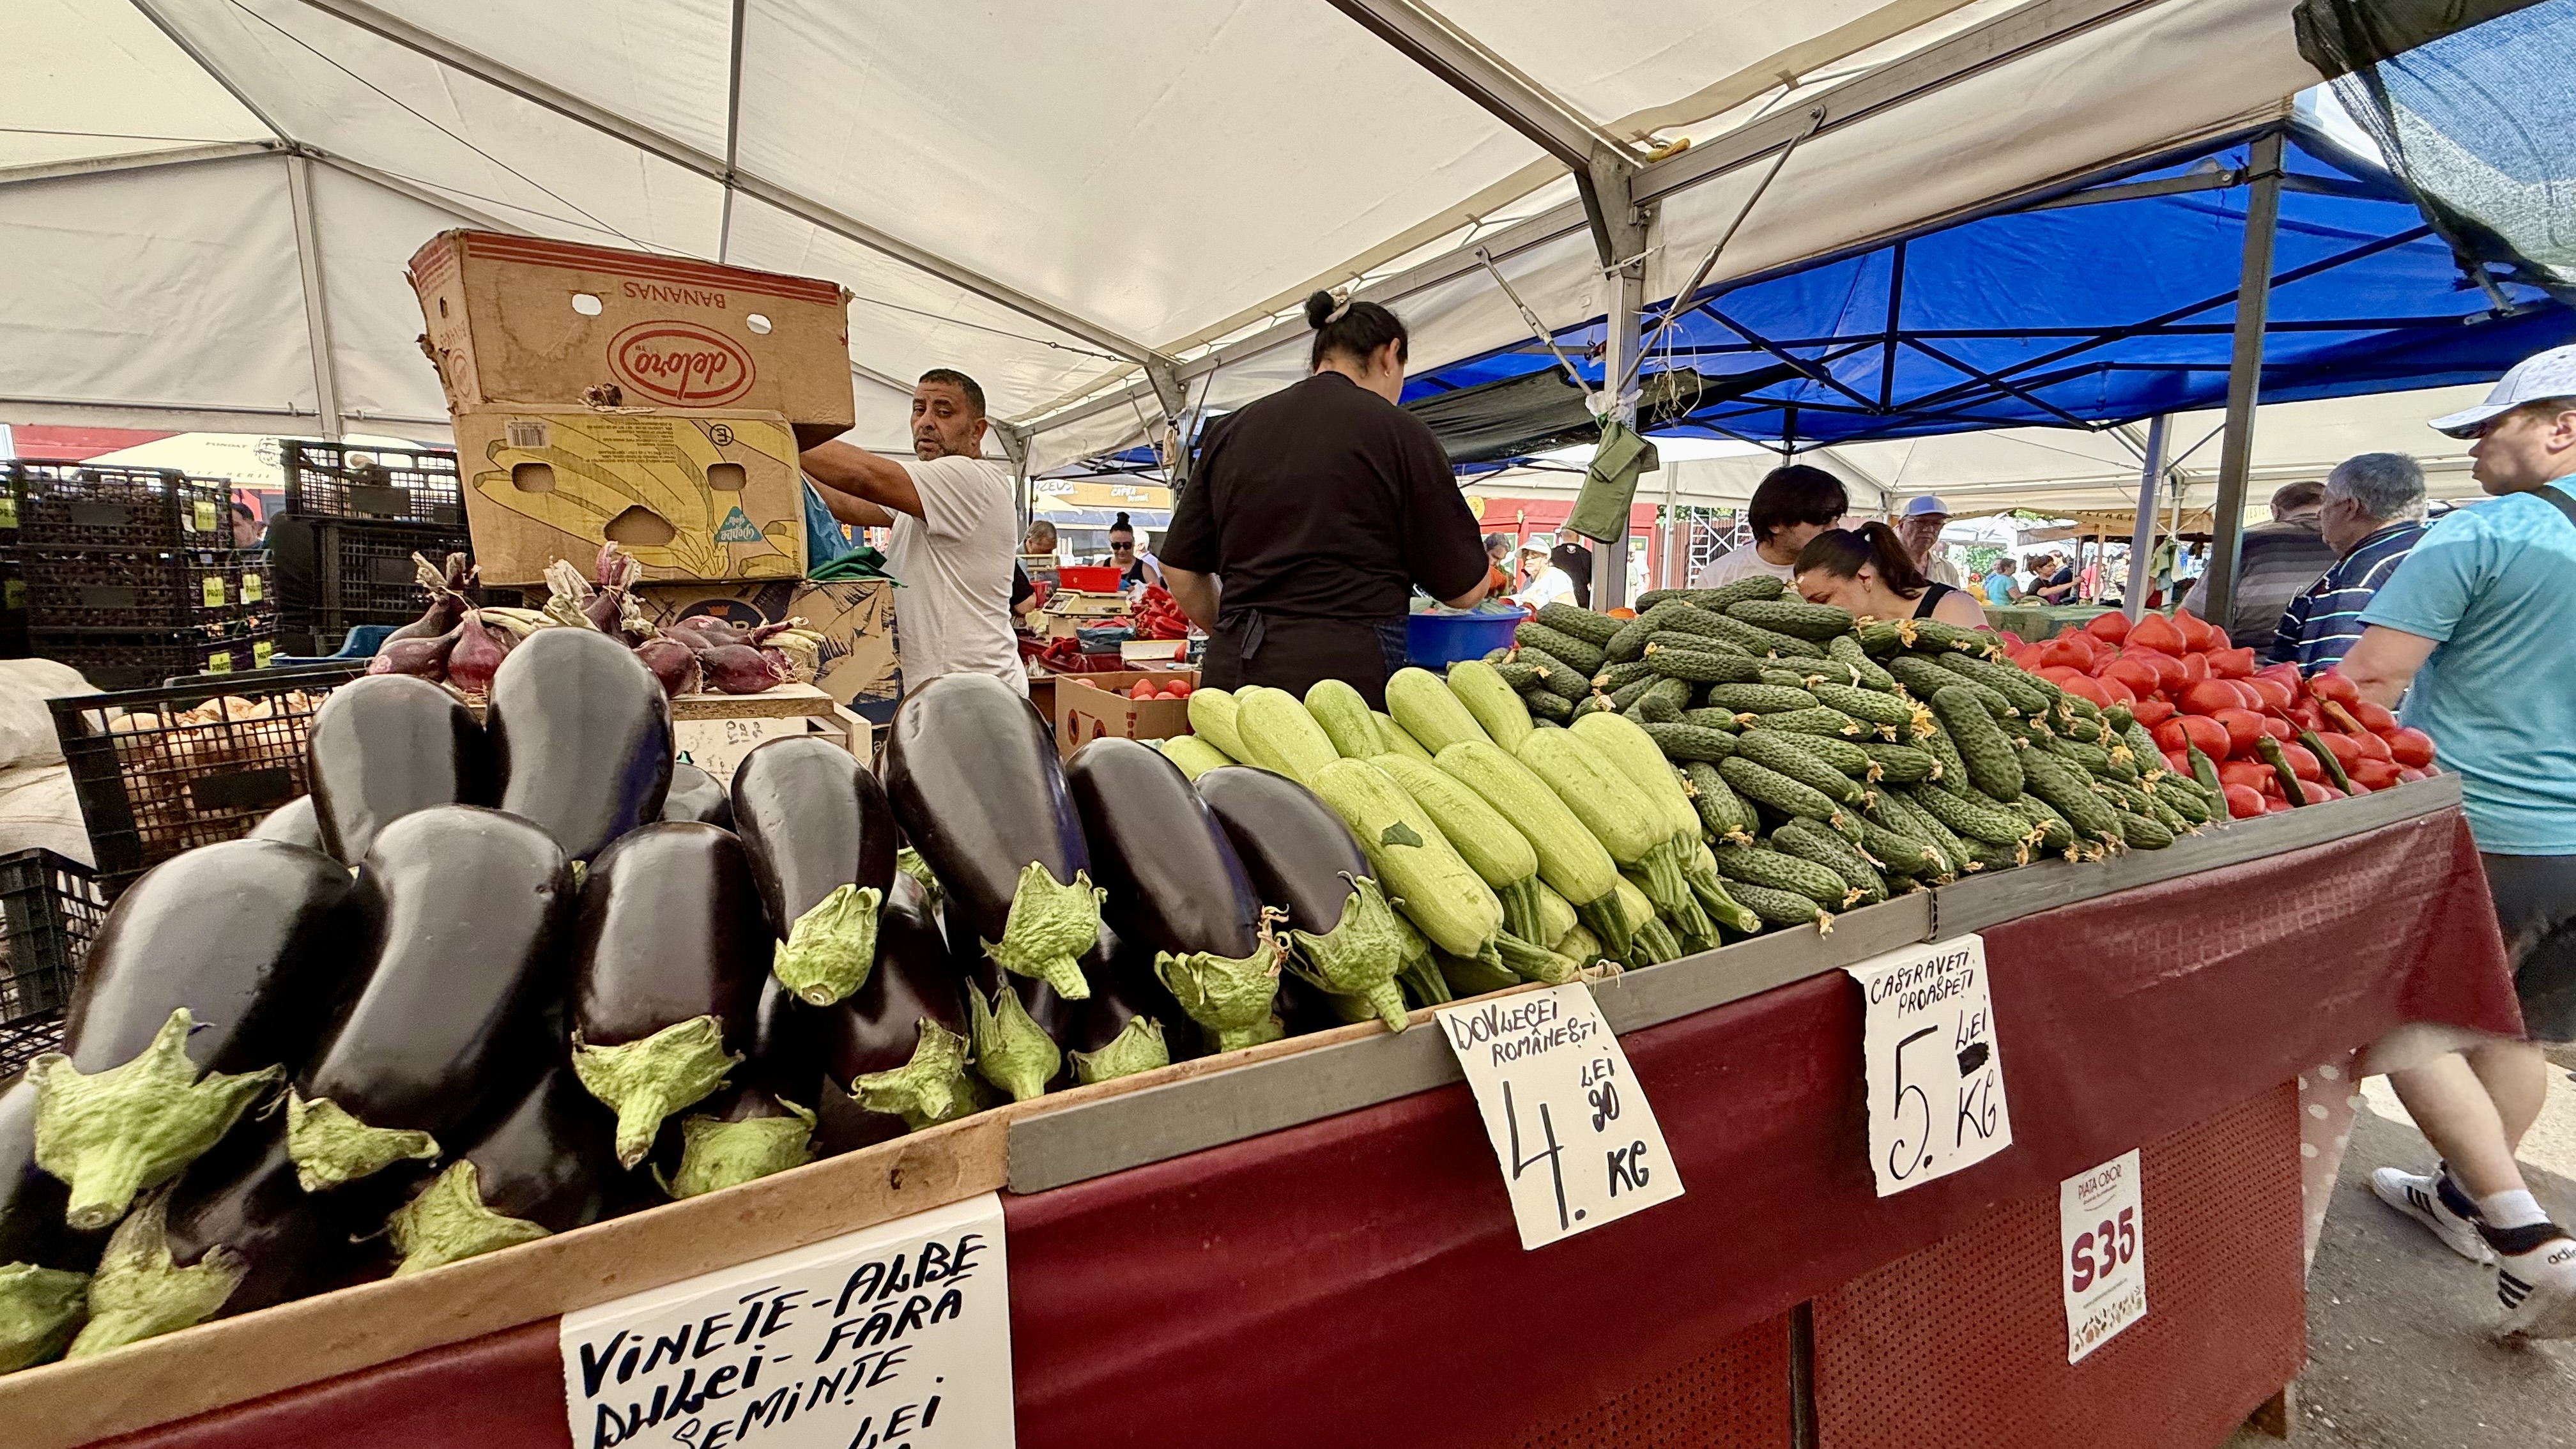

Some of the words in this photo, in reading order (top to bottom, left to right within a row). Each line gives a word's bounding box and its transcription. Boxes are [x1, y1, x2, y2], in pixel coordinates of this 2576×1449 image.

[624, 281, 726, 309] BANANAS
[1955, 994, 1988, 1050] LEI
[1581, 1046, 1616, 1088] LEI
[1588, 1081, 1620, 1133] 90
[1956, 1069, 1996, 1148] KG
[1607, 1140, 1650, 1198] KG
[2071, 1206, 2135, 1293] S35
[2547, 1248, 2576, 1264] adi
